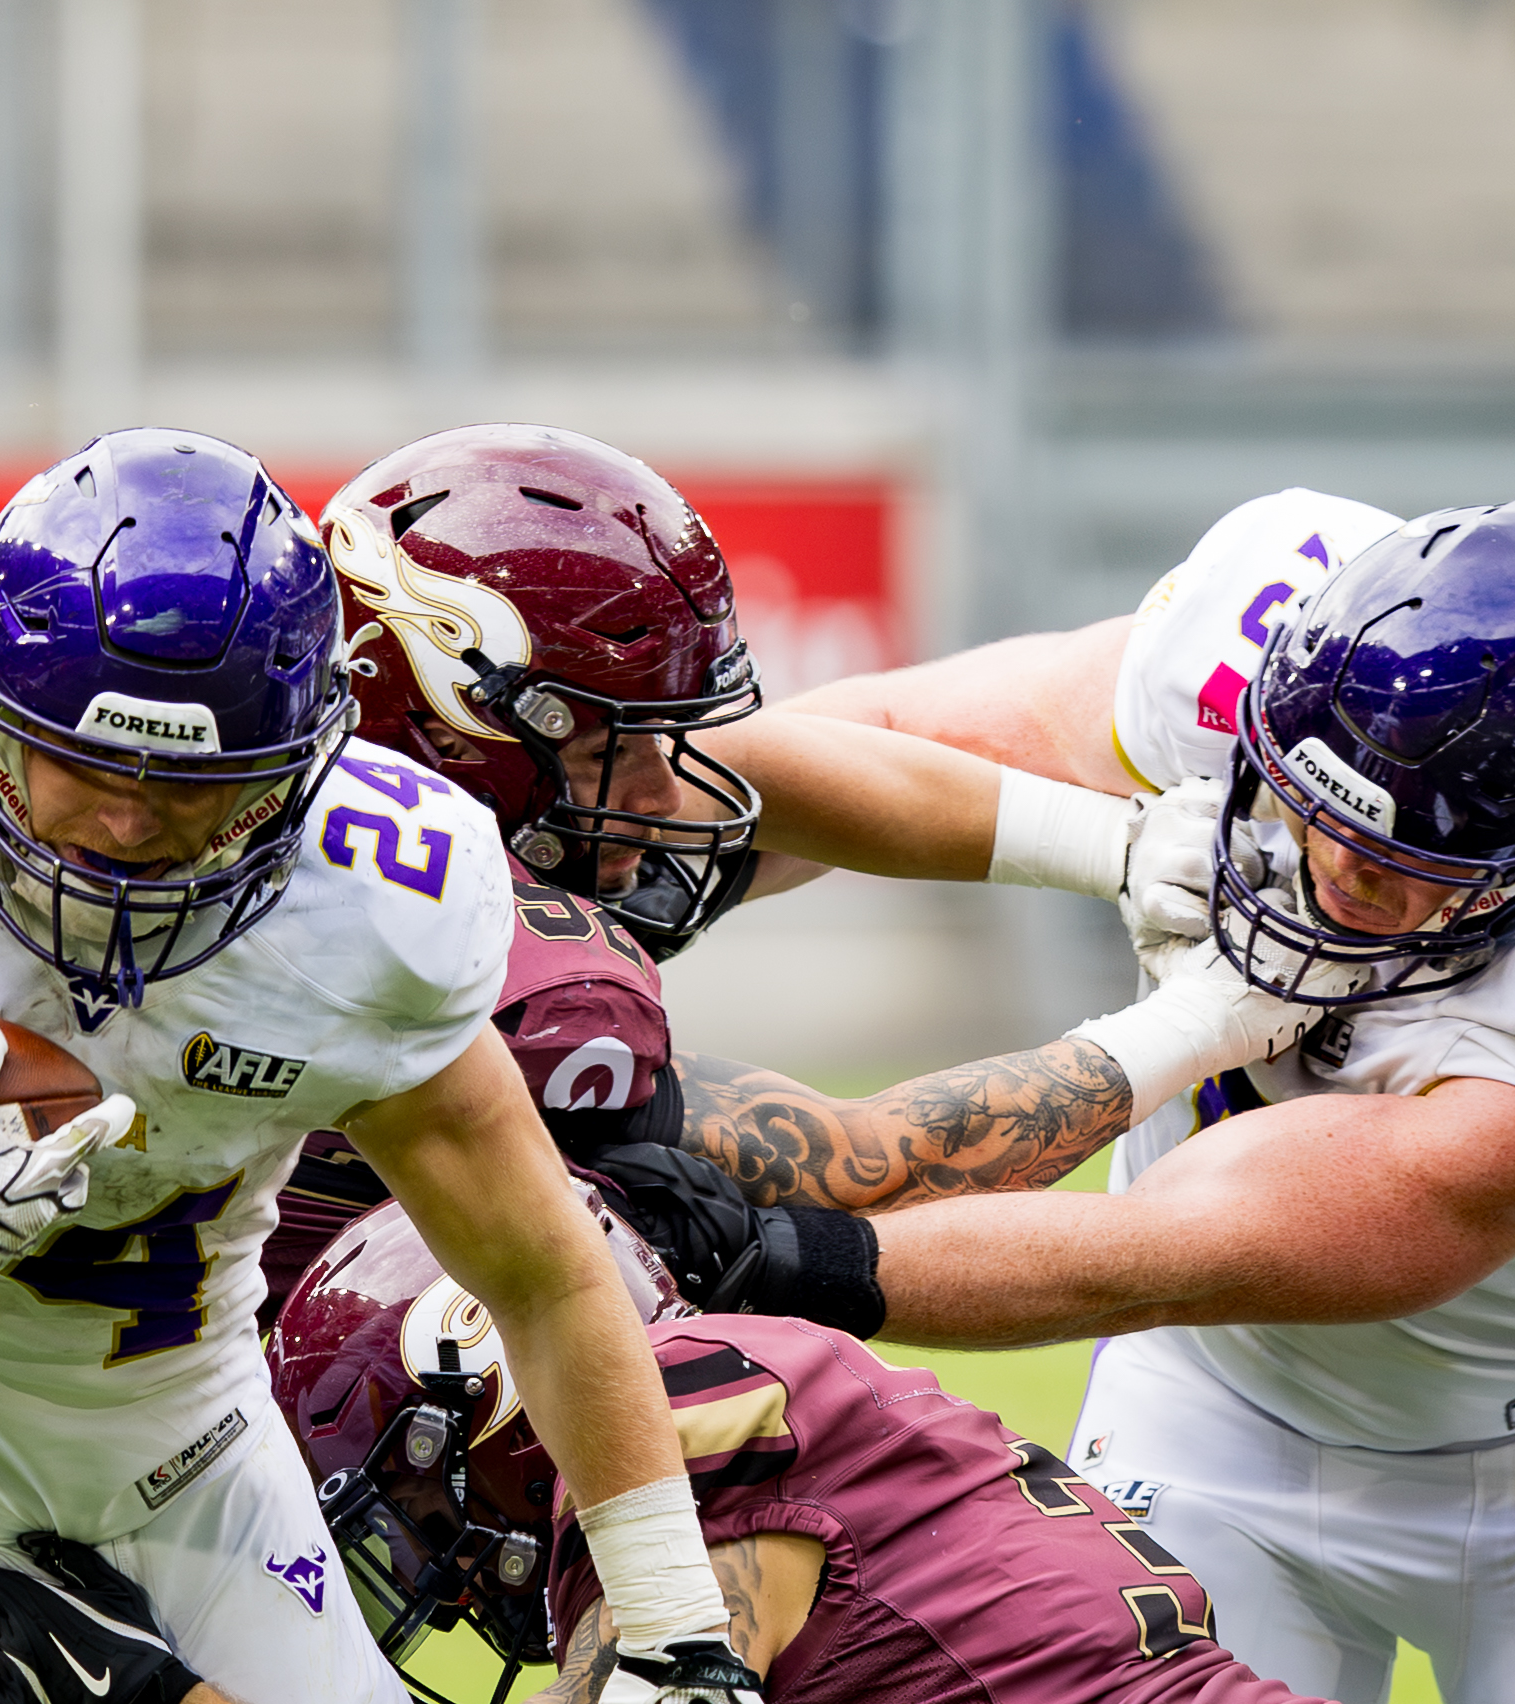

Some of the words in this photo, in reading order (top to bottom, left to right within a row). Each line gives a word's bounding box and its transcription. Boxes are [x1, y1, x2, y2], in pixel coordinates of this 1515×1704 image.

[94, 706, 207, 743] FORELLE
[1294, 749, 1381, 822] FORELLE
[210, 792, 284, 853] Riddell
[319, 752, 454, 904] 24
[194, 1045, 304, 1091] AFLE
